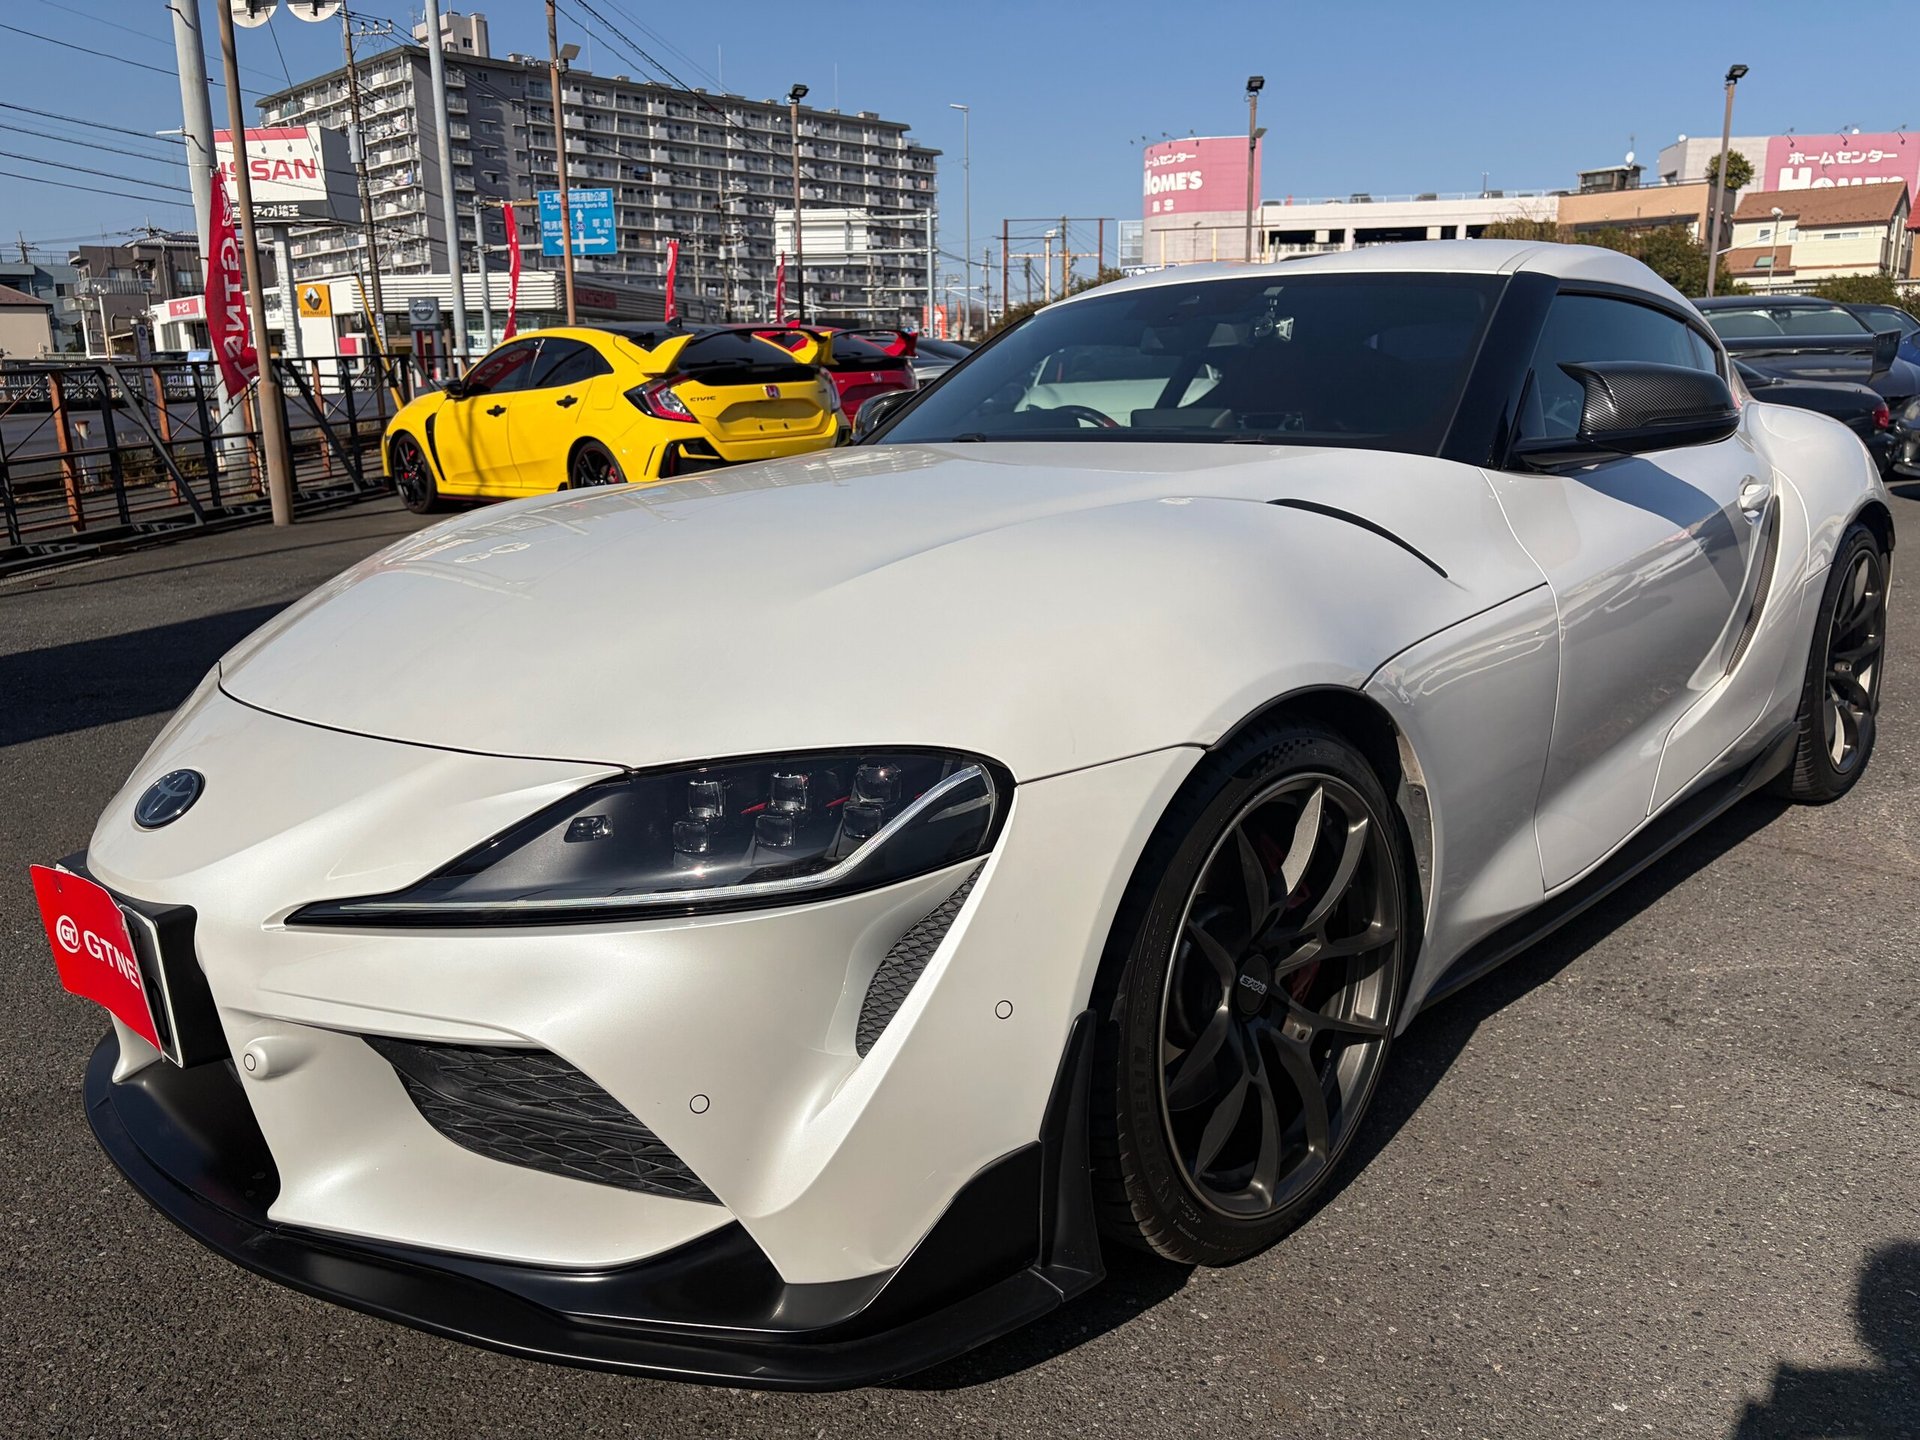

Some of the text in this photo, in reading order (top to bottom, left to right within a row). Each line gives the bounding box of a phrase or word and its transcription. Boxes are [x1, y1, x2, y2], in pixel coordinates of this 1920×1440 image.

[1787, 149, 1898, 165] ホームセンター
[83, 930, 141, 990] GTNE
